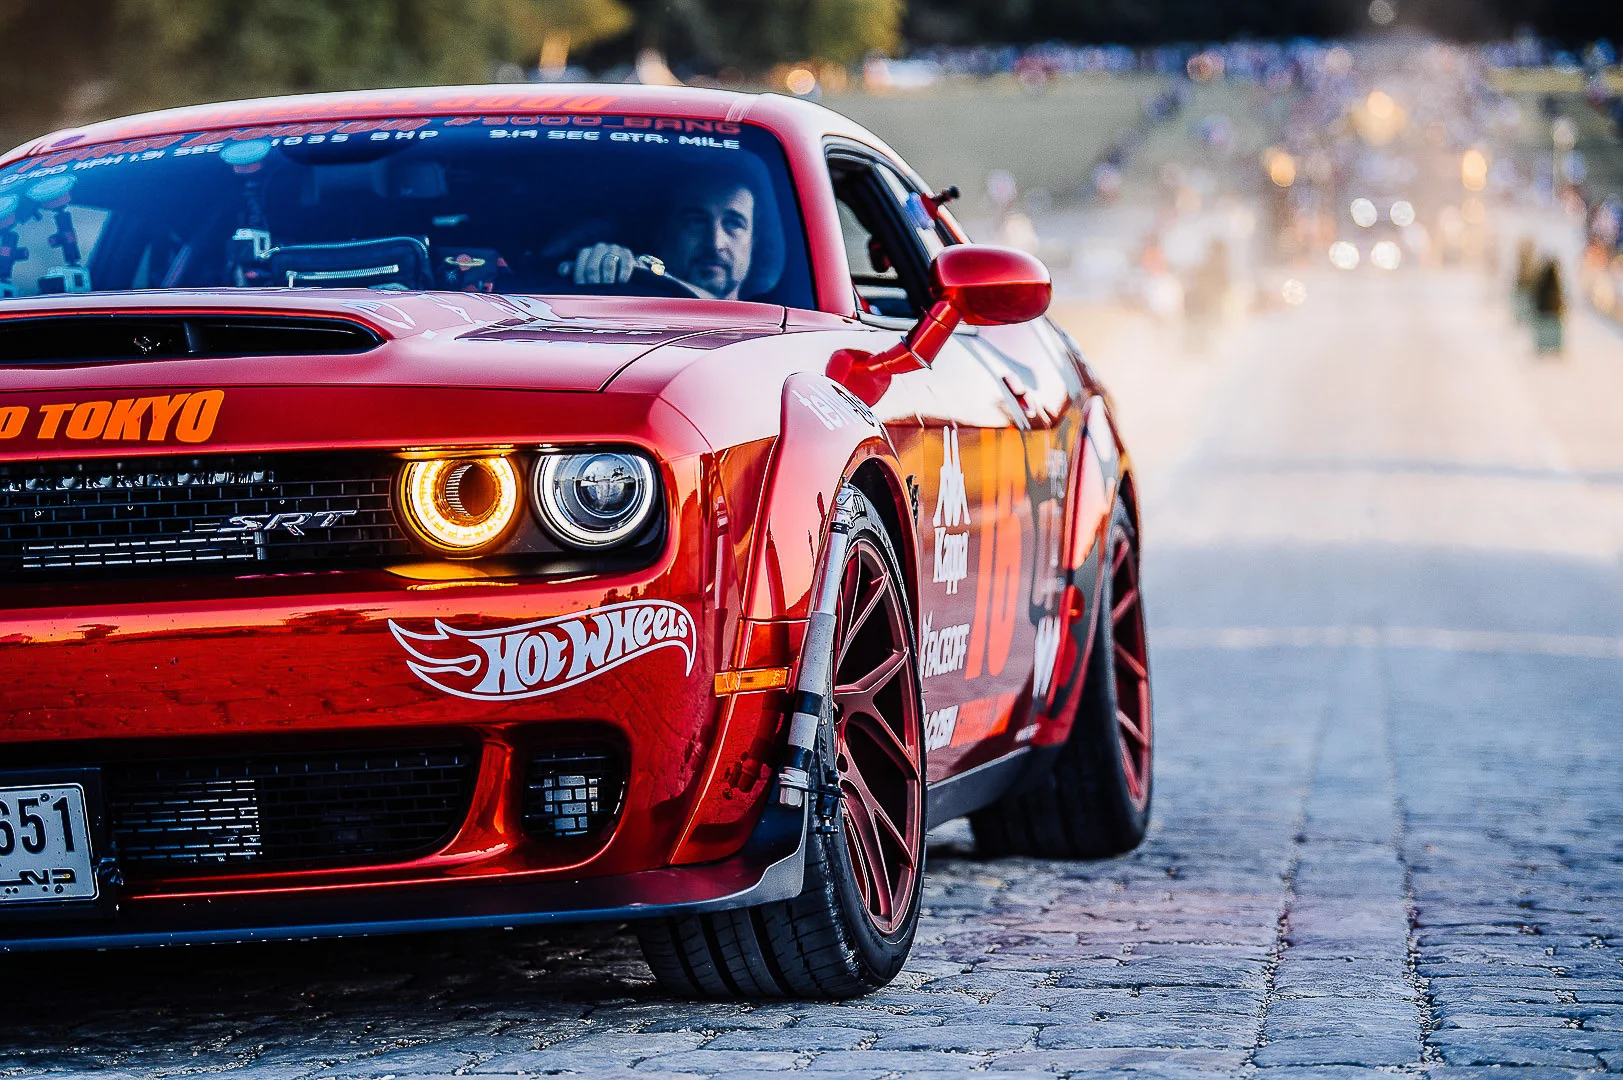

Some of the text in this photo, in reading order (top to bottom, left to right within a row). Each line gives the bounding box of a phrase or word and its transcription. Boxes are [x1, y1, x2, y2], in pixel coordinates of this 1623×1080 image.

[270, 129, 439, 147] 1035 BHP
[489, 129, 740, 149] 9.14 SEC QTR. MILE
[73, 155, 121, 172] KPH
[174, 143, 224, 157] SEC
[37, 389, 225, 443] TOKYO
[216, 509, 357, 536] SRT
[933, 527, 970, 595] Kappa
